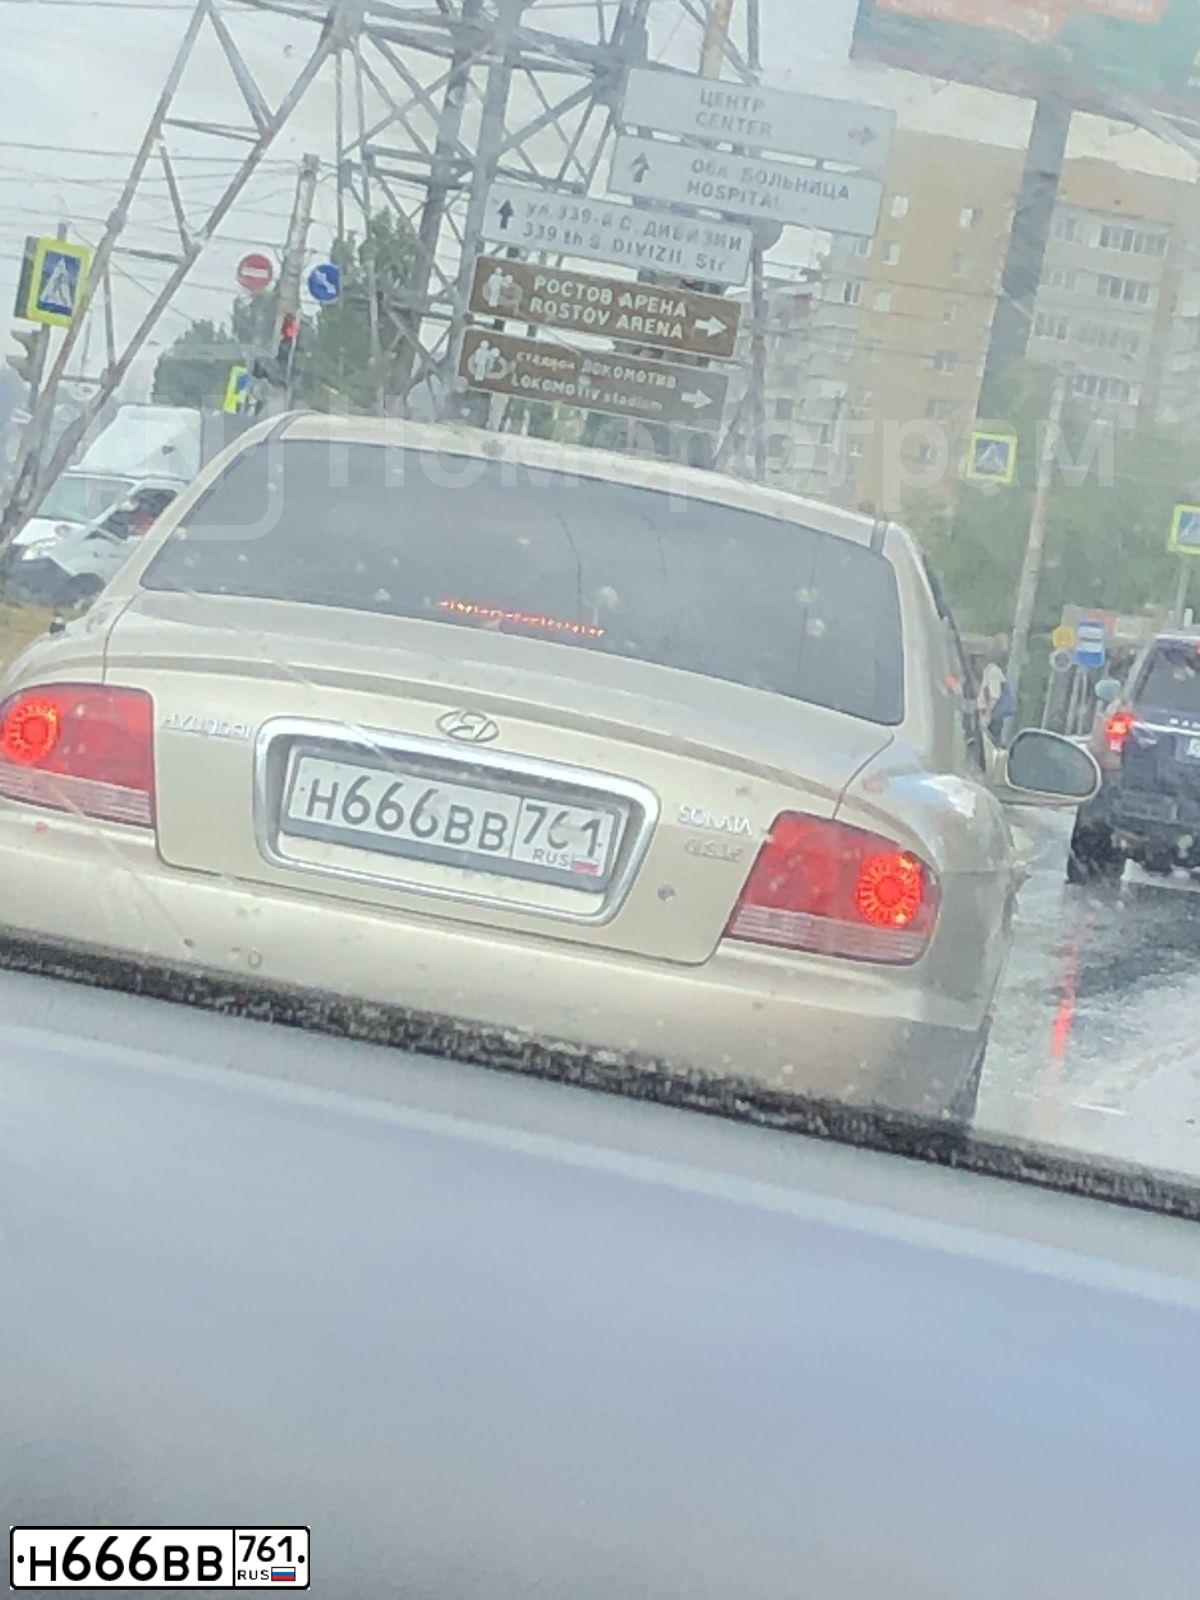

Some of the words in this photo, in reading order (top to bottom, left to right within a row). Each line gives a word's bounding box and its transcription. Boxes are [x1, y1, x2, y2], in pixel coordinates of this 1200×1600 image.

[700, 88, 765, 114] ЦЕНТР
[695, 111, 773, 138] CENTER
[741, 164, 851, 200] БОЛЬНИЦА
[612, 238, 683, 265] DIVIZII
[696, 253, 726, 273] Str
[534, 275, 613, 305] РОСТОВ
[618, 292, 688, 318] АРЕНА
[529, 296, 611, 327] ROSTOV
[616, 315, 684, 340] ARENA
[522, 804, 601, 858] 761
[531, 848, 569, 869] RUS
